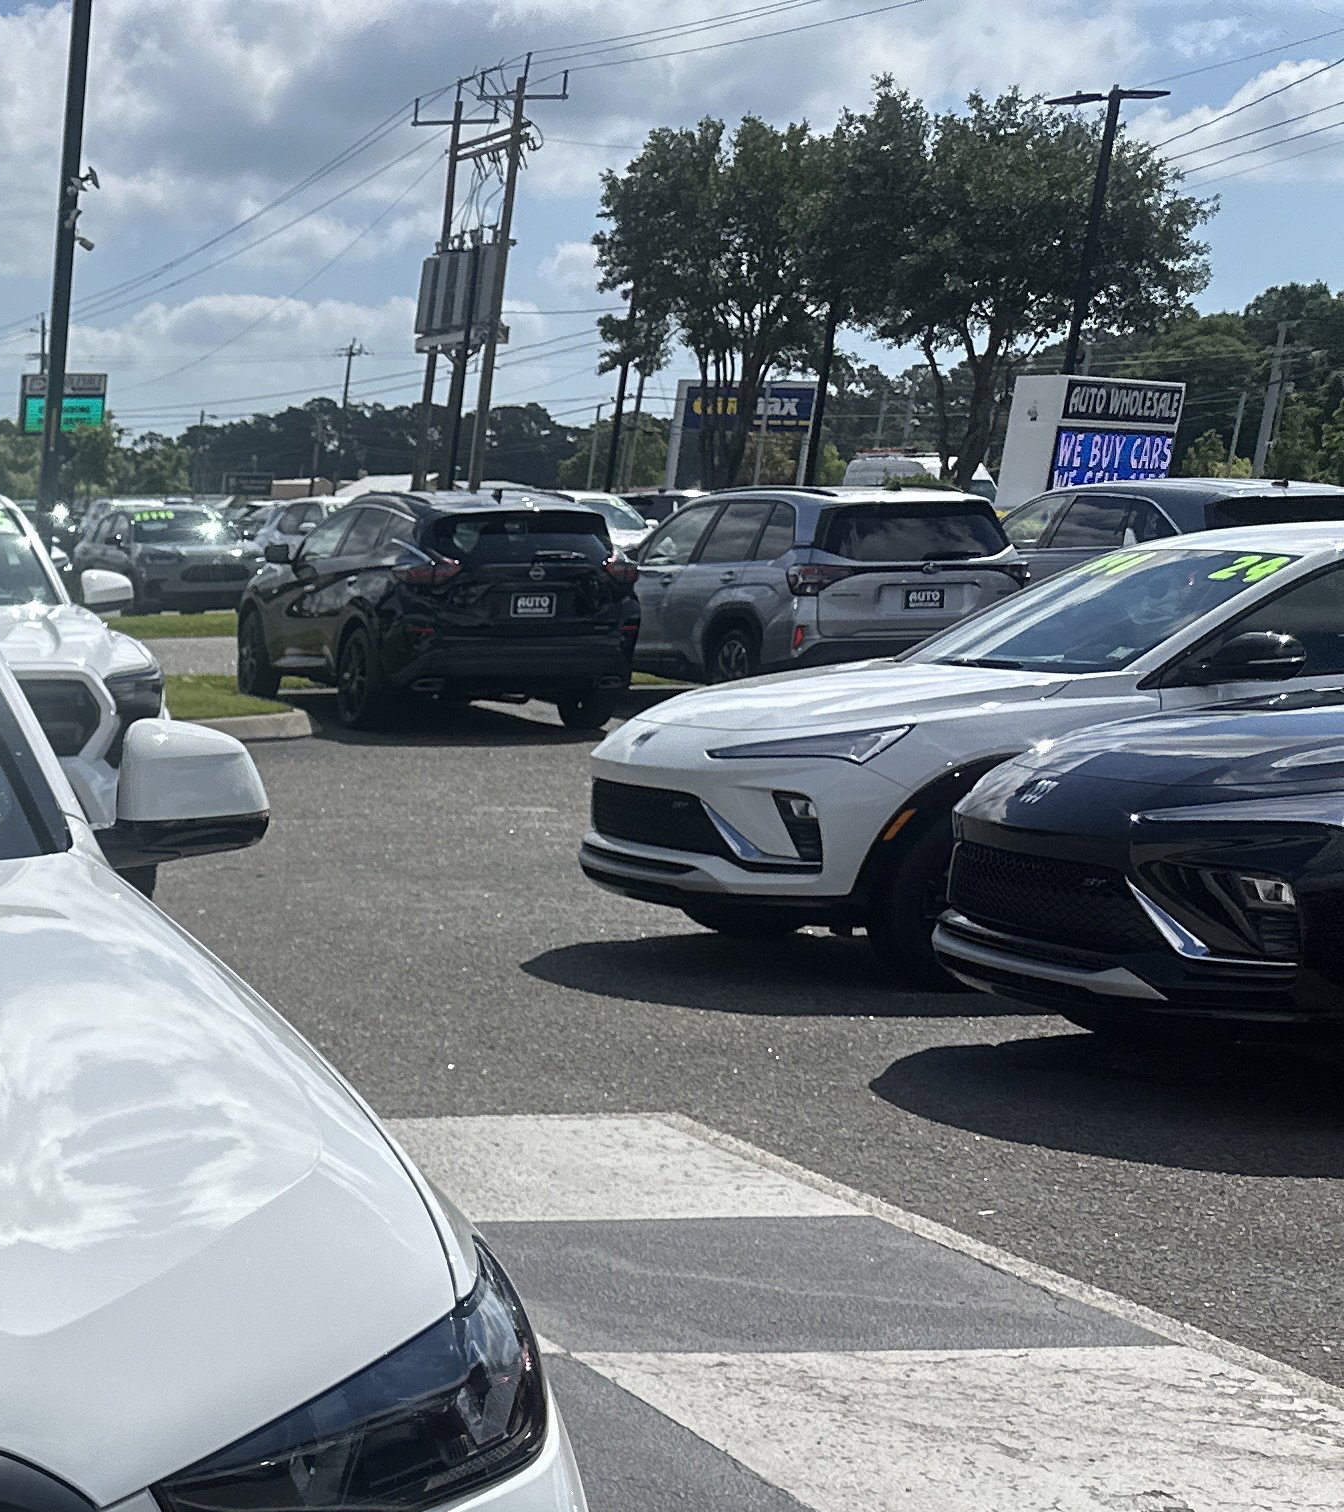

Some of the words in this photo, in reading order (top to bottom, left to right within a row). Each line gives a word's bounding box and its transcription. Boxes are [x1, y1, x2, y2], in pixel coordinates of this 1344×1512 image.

[1069, 386, 1106, 414] AUTO
[1109, 388, 1180, 418] WHOLESALE
[1057, 432, 1084, 467] WE
[1088, 434, 1126, 469] BUY
[1130, 437, 1173, 470] CARS
[517, 596, 550, 608] AUTO
[909, 591, 940, 602] AUTO
